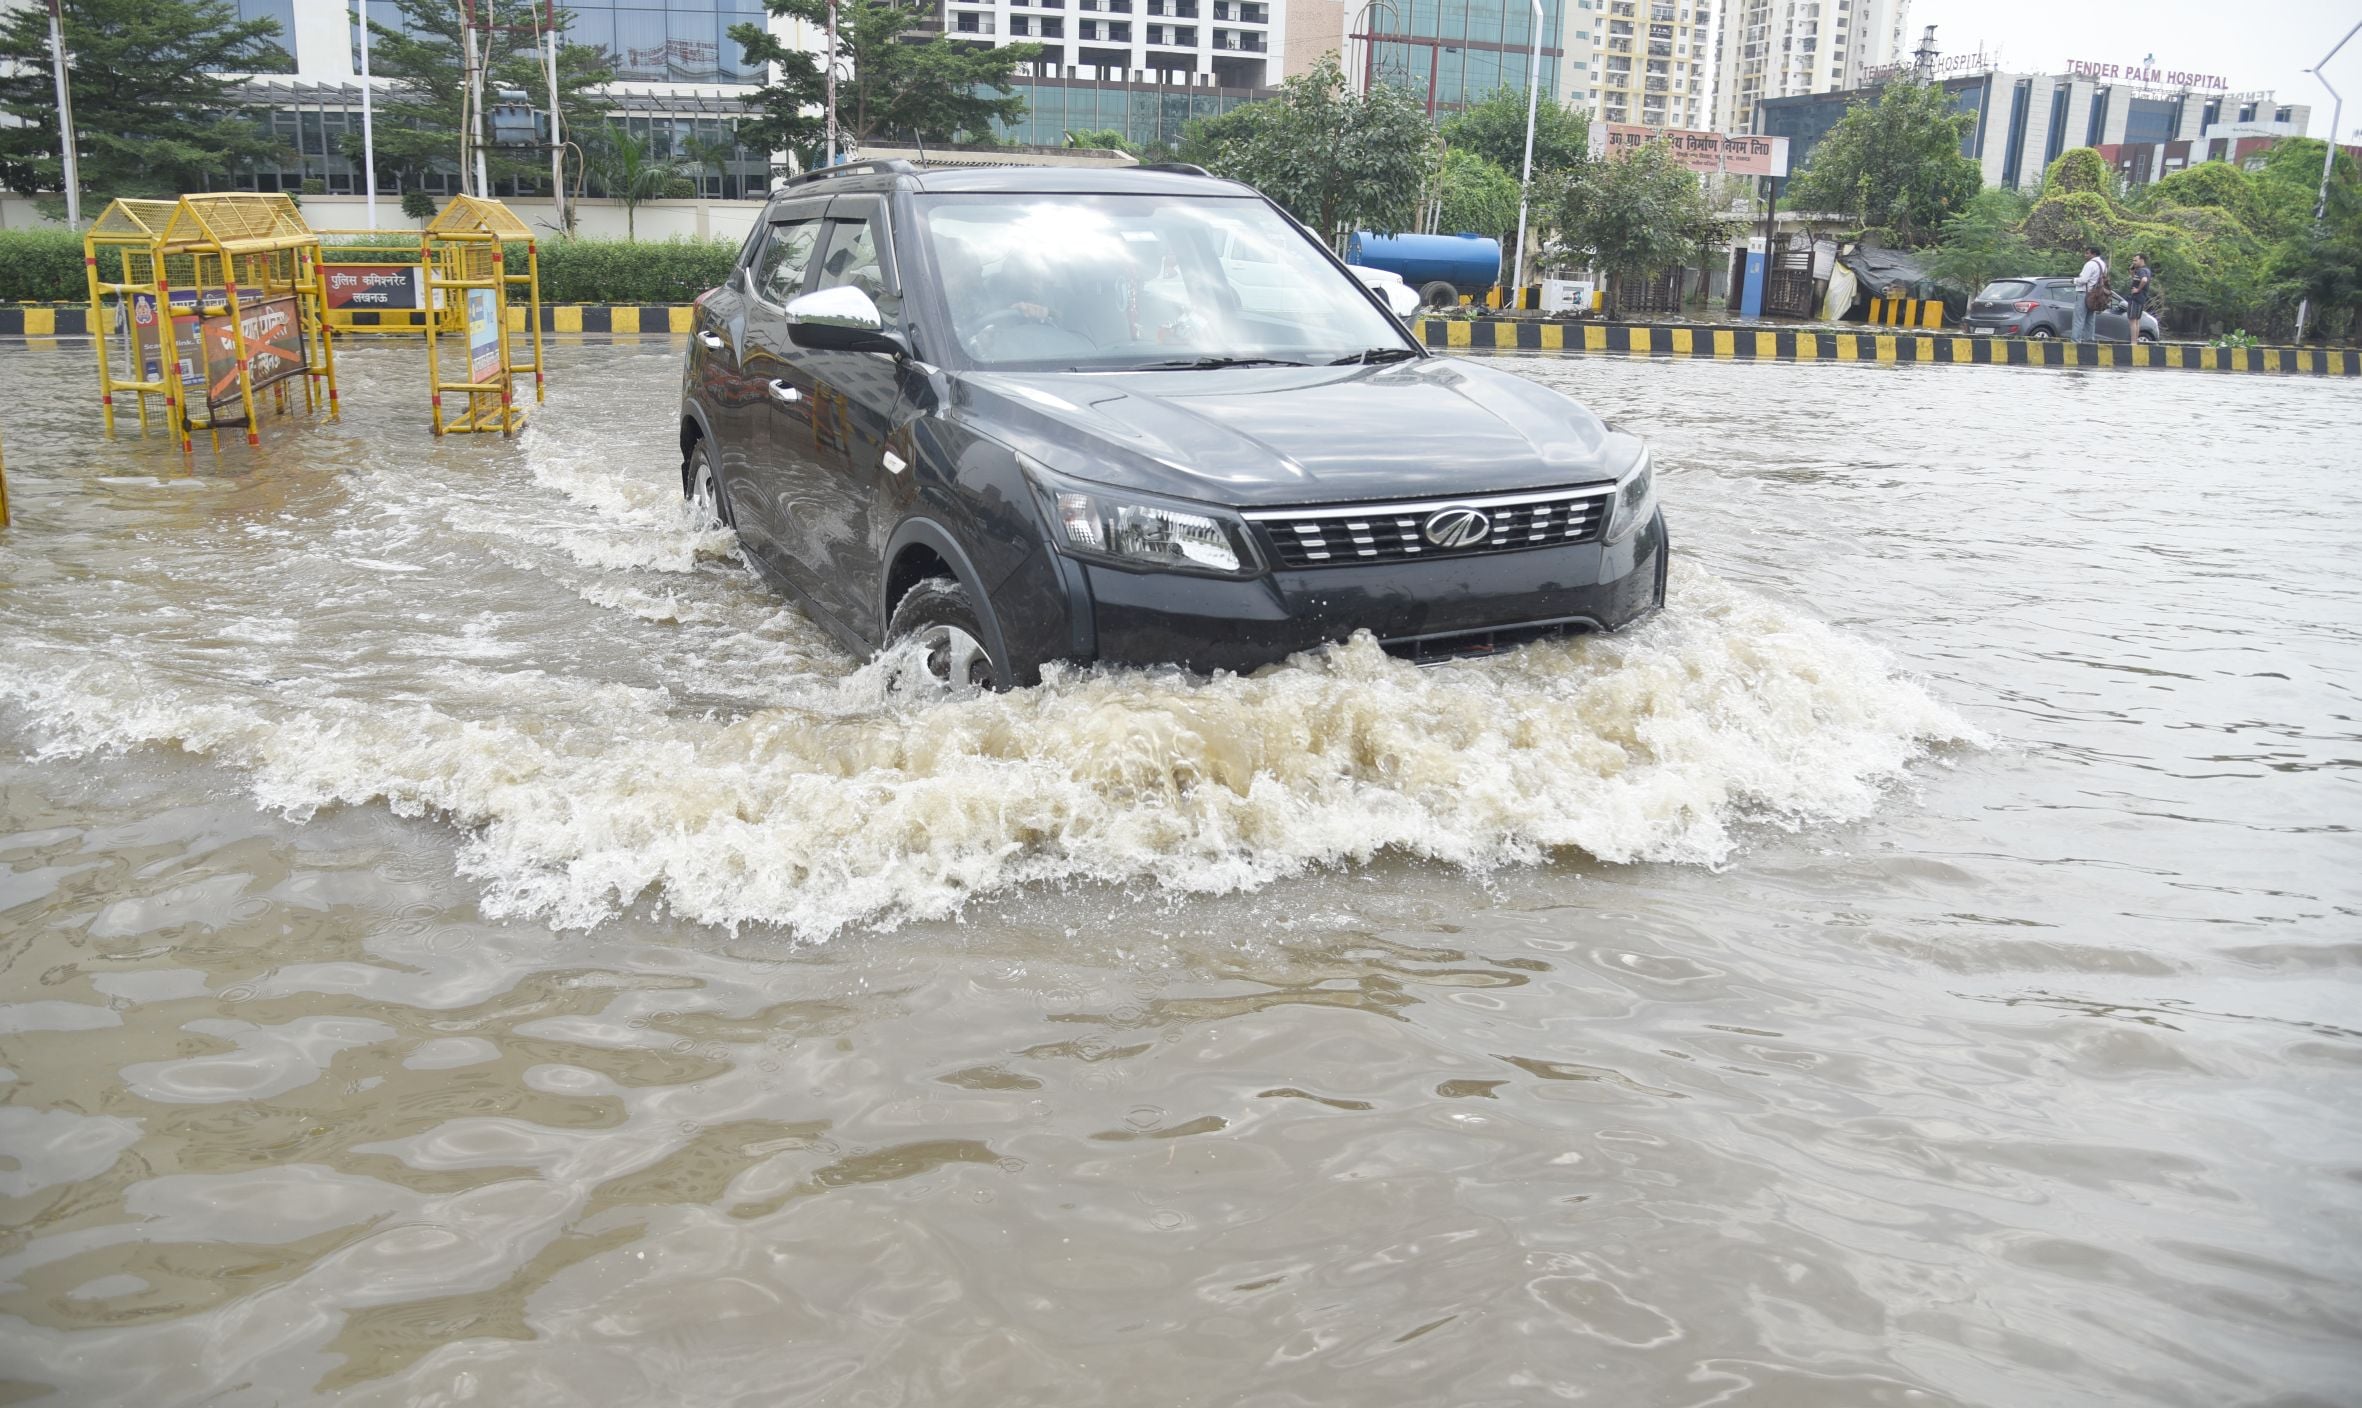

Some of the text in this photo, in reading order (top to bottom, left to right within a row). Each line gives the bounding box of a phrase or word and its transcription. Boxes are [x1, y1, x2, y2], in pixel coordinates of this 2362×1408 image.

[1937, 52, 1989, 73] HOSPITAL
[2067, 59, 2229, 90] TENDER PALM HOSPITAL
[1687, 135, 1718, 152] निर्माण
[331, 273, 406, 289] पुलिस कमिश्नरेट
[352, 293, 388, 303] लखनऊ
